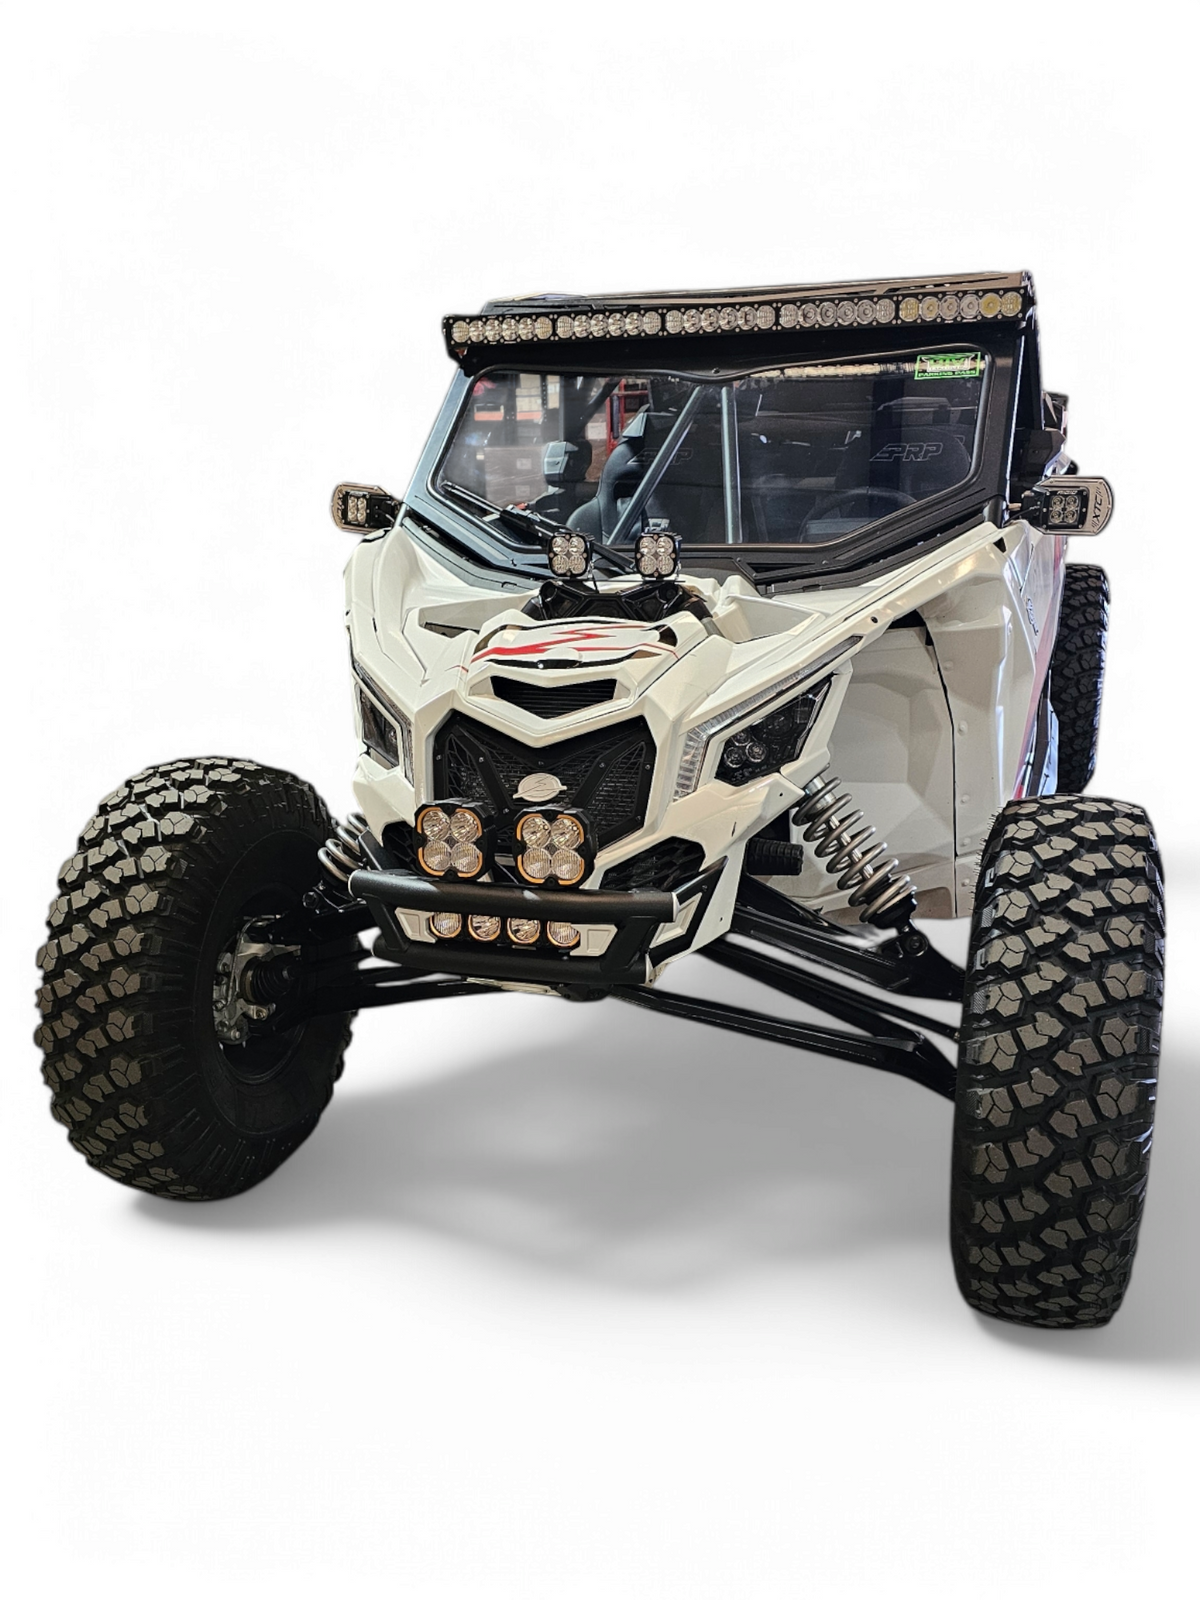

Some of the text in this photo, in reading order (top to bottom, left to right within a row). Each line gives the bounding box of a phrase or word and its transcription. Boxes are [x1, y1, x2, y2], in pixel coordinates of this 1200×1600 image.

[626, 447, 693, 466] PP
[869, 442, 943, 461] PRP
[1092, 494, 1103, 523] XTC
